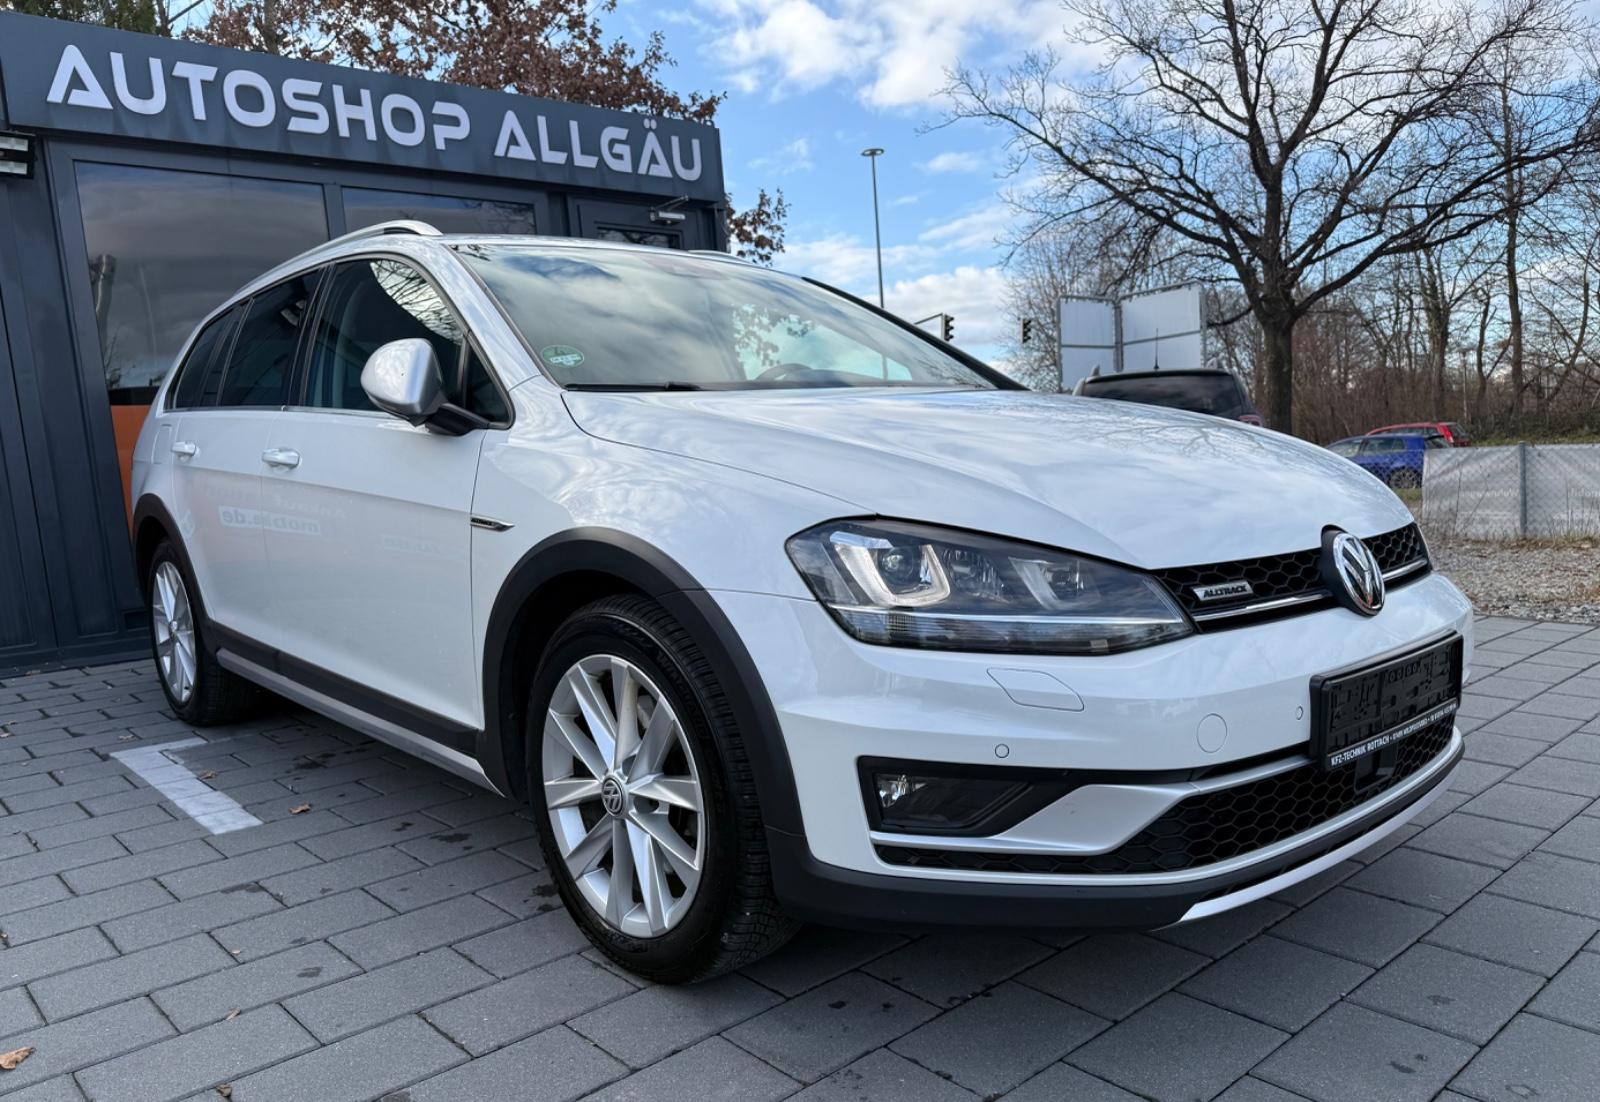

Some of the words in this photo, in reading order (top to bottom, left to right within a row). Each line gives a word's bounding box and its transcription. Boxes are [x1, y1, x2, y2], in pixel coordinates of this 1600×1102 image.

[46, 44, 471, 150] AUTOSHOP
[494, 110, 702, 181] ALLGÄU
[1330, 744, 1367, 766] KFZ-TECHNIK
